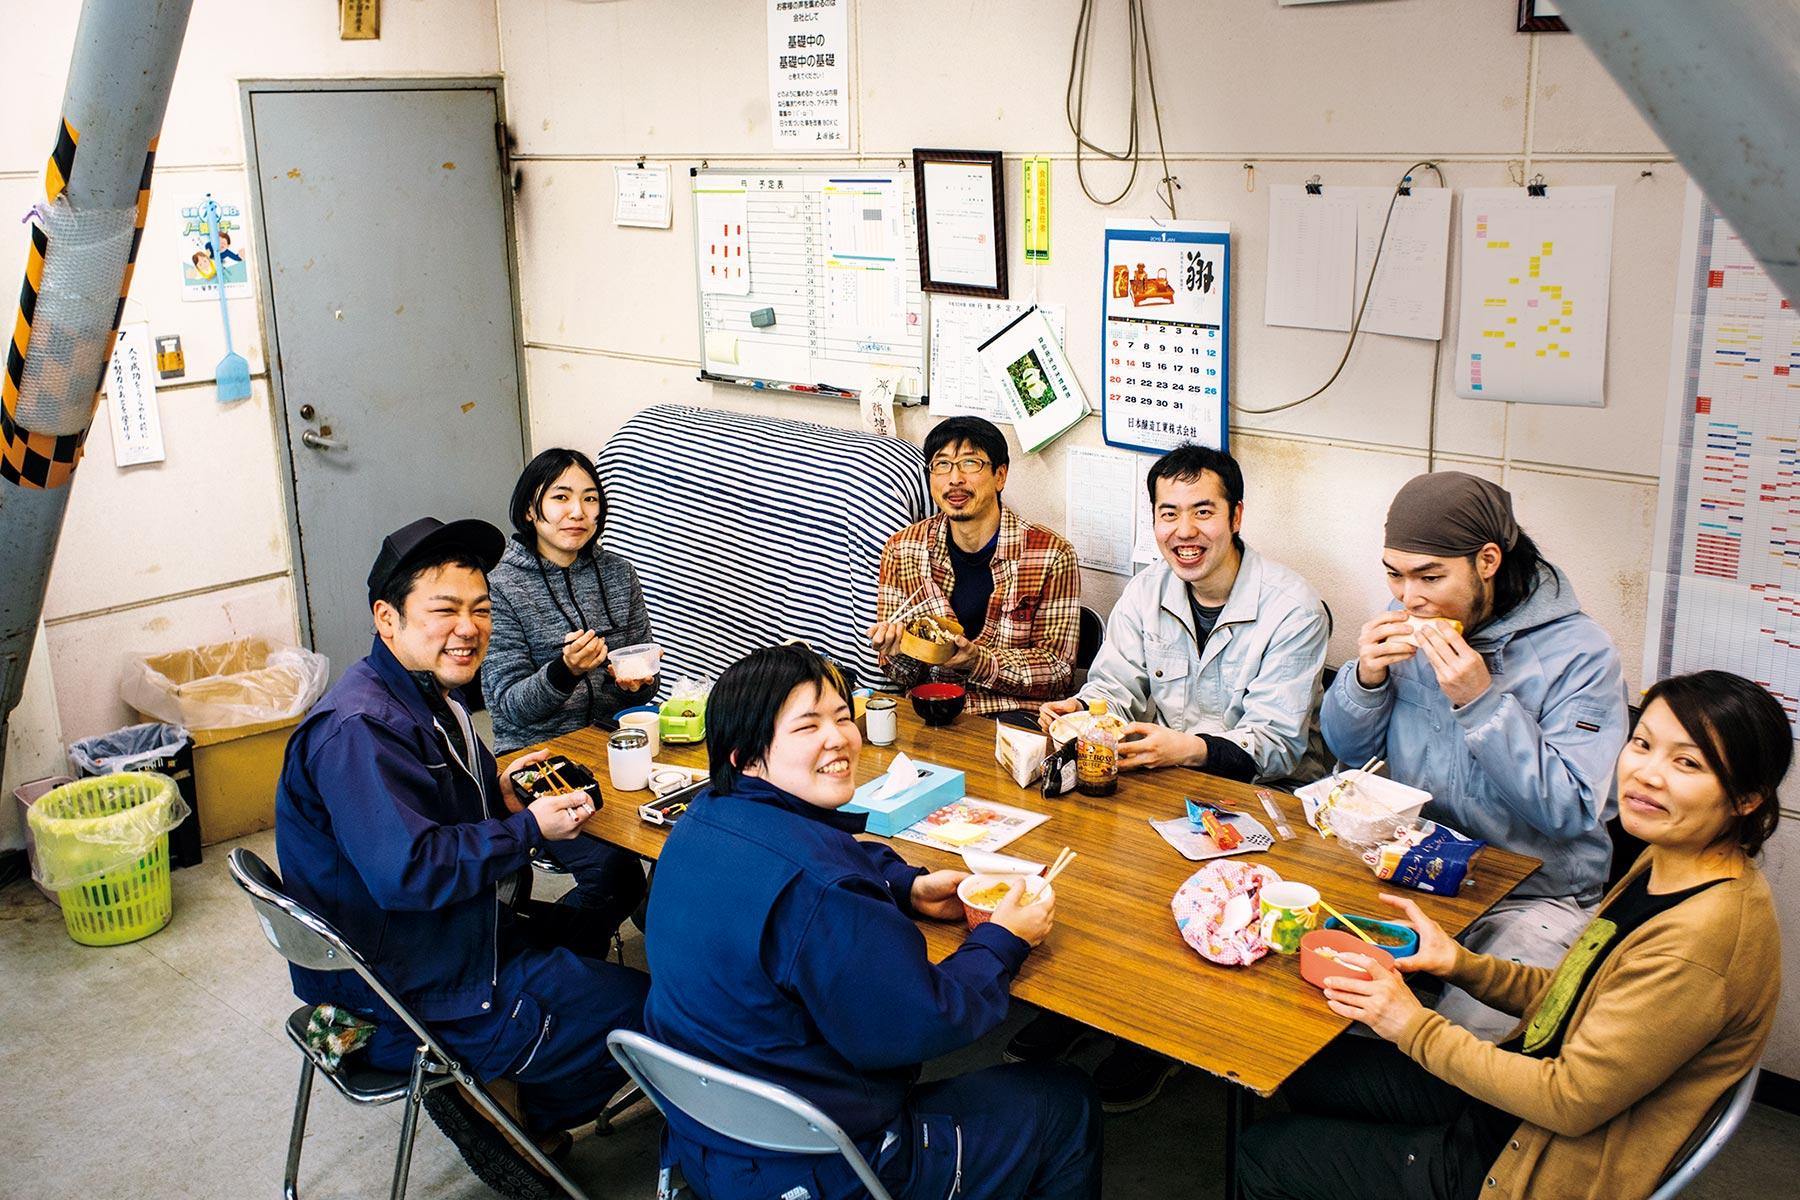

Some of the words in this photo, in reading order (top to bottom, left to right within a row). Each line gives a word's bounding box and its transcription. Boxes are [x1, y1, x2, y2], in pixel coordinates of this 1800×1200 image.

[793, 13, 819, 22] 会社として
[788, 34, 825, 48] 基礎中の
[780, 53, 835, 69] 基礎中の基礎
[760, 180, 784, 189] 予定表
[1161, 232, 1166, 241] 1
[1128, 417, 1197, 438] 日本醸造工業株式会社
[1365, 854, 1376, 863] 8
